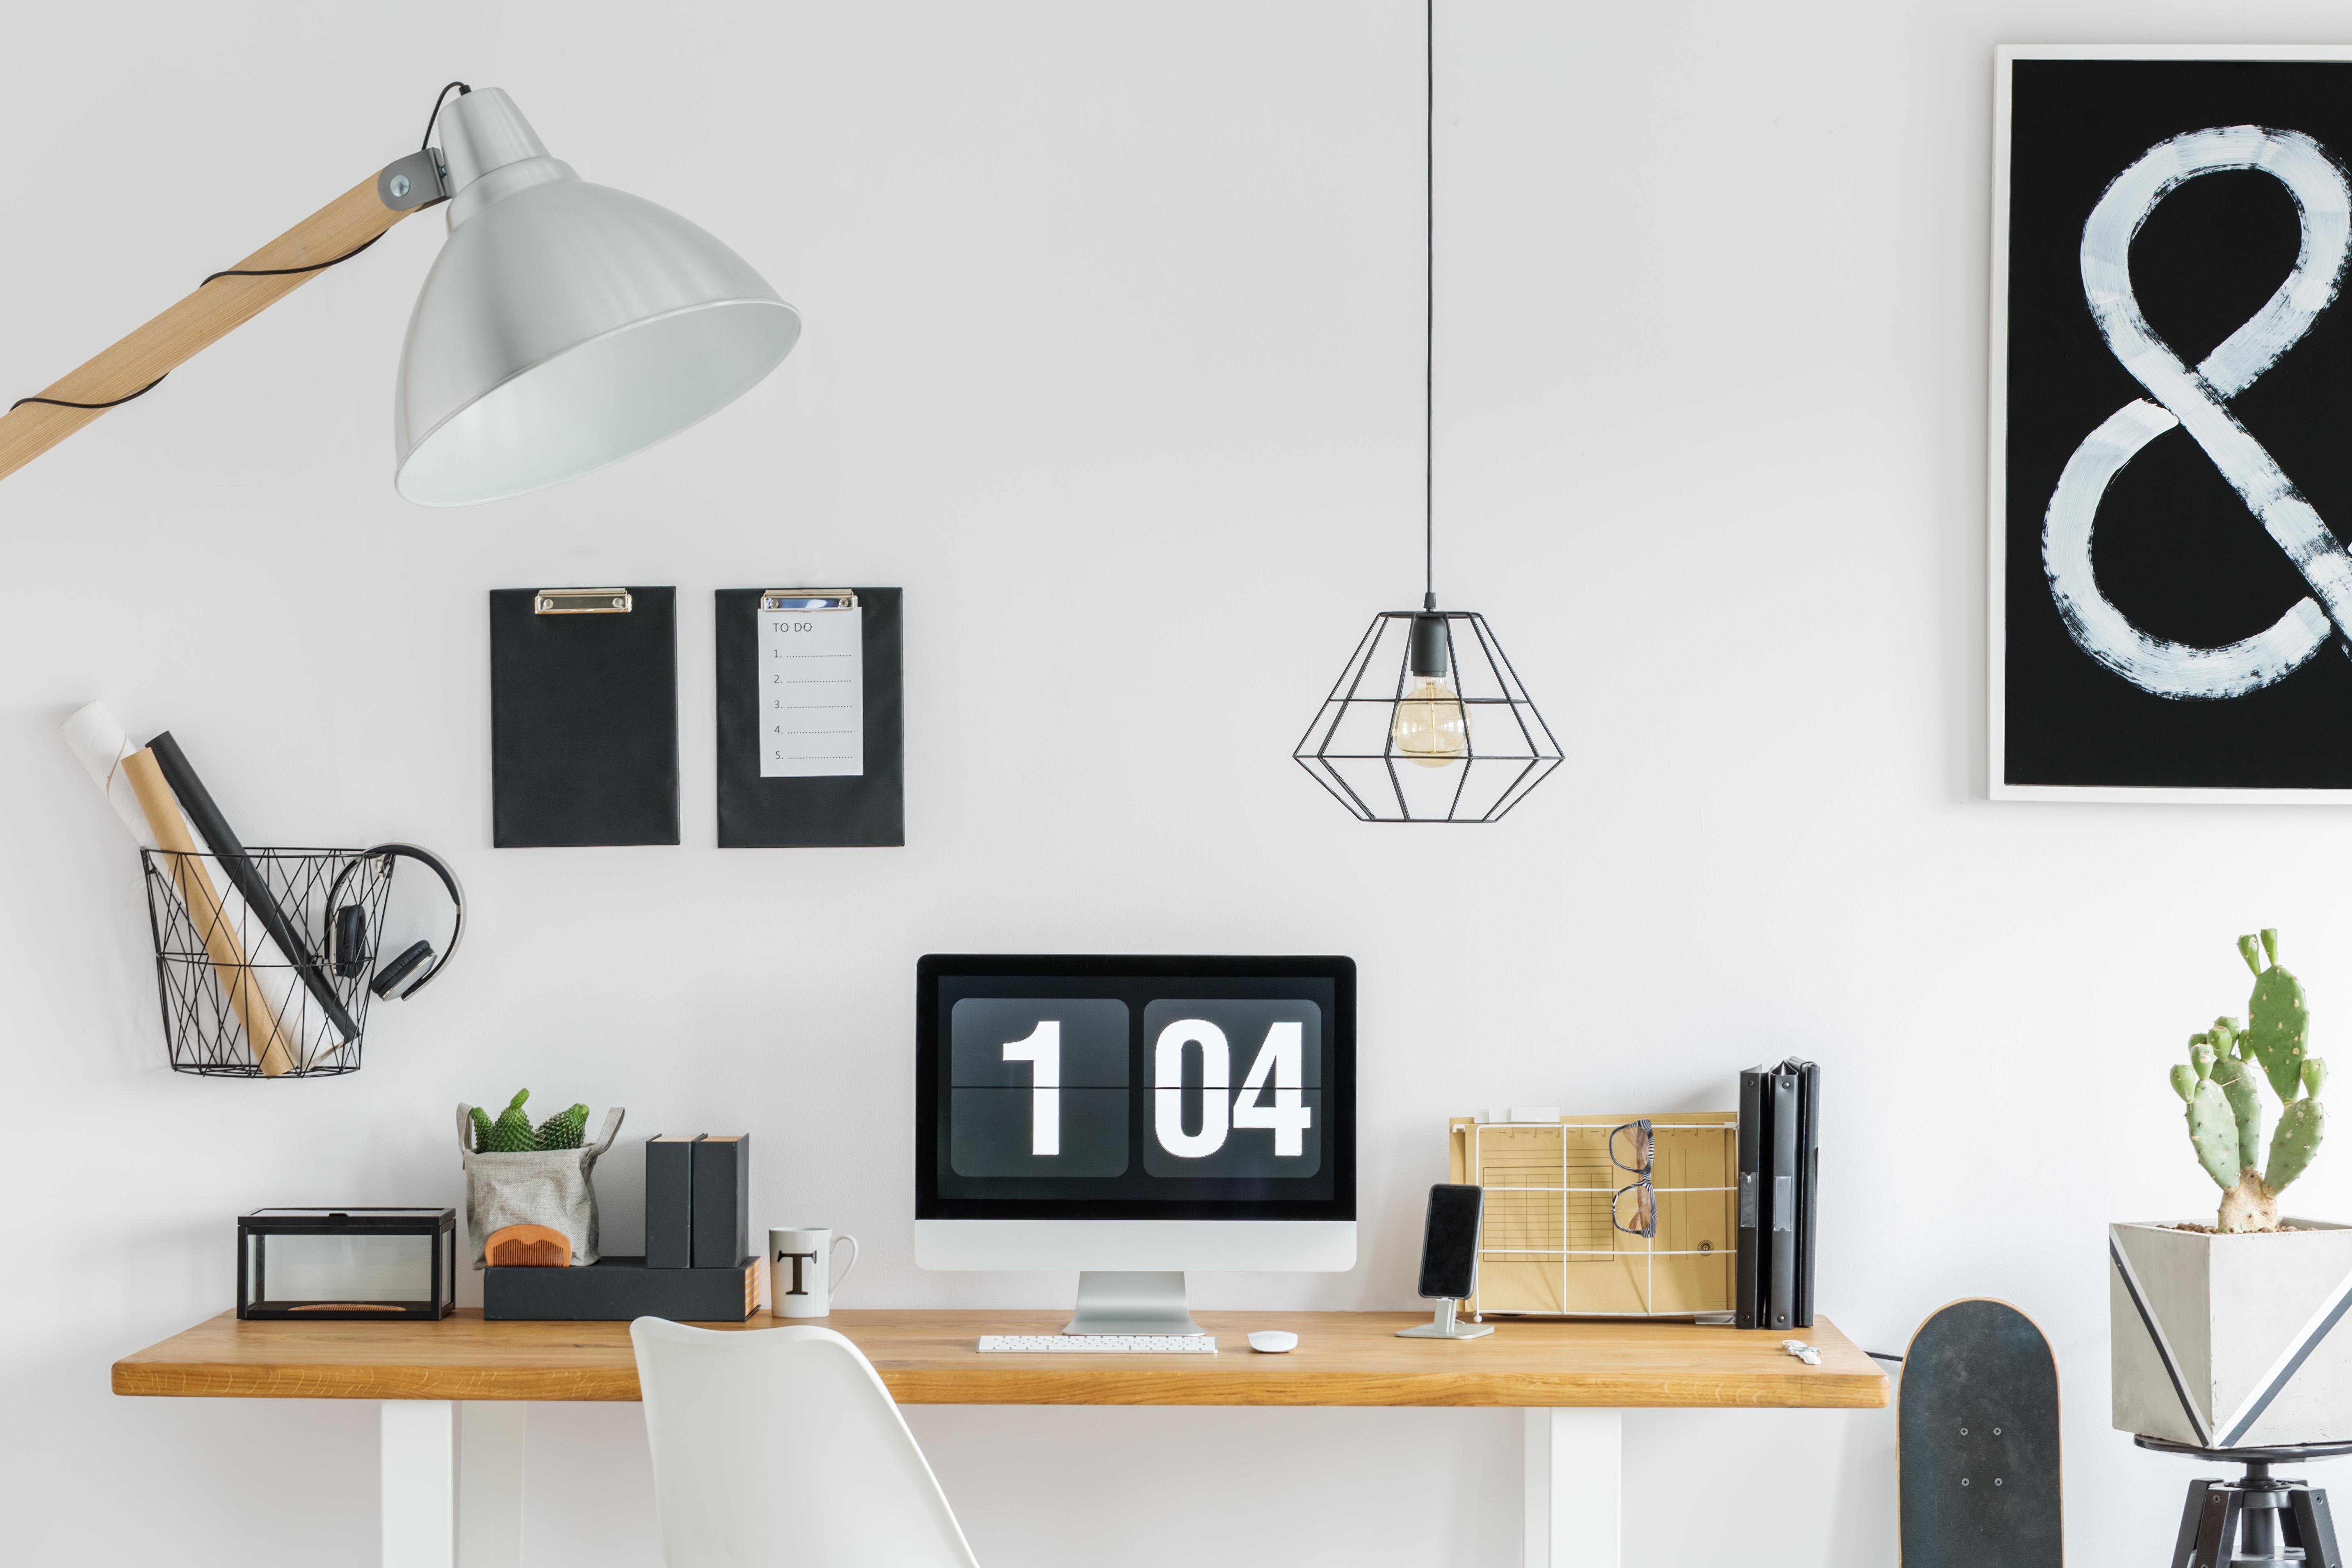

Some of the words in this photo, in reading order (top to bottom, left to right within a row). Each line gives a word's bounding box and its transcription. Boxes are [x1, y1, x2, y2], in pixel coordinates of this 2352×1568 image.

[772, 623, 789, 632] TO
[794, 622, 812, 632] DO
[773, 649, 782, 658] 1.
[774, 675, 782, 683] 2.
[774, 700, 783, 709] 3.
[774, 726, 783, 734] 4.
[775, 751, 783, 760] 5.
[1002, 1021, 1060, 1156] 1
[1155, 1019, 1311, 1158] 04
[777, 1250, 817, 1295] T
